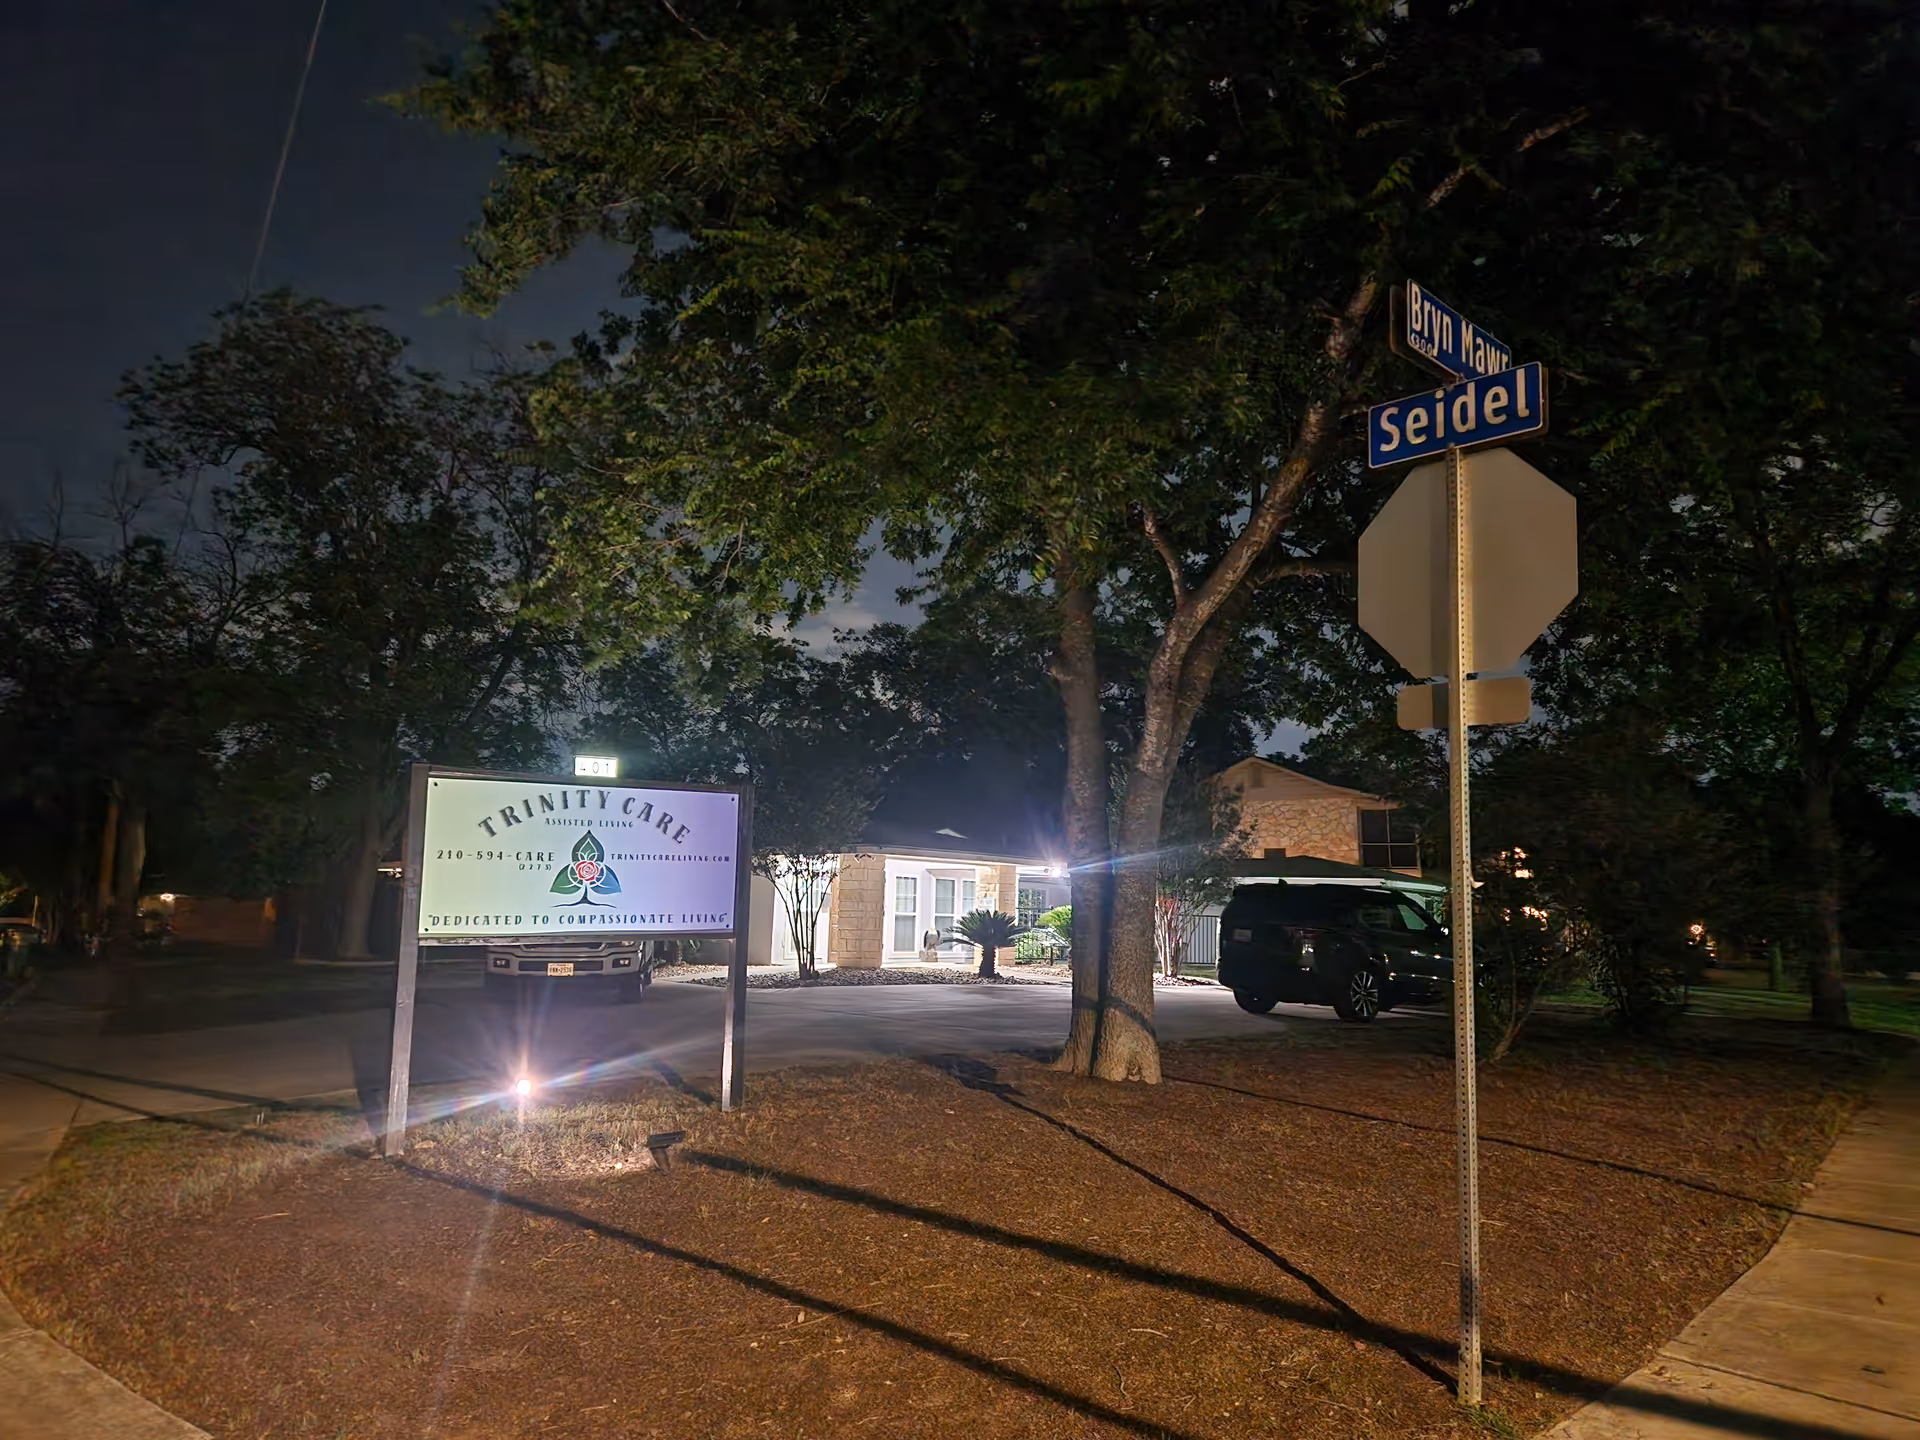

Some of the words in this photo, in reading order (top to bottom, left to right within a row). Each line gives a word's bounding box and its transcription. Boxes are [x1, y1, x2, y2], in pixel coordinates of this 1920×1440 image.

[1411, 283, 1453, 357] Bryn
[1460, 320, 1509, 375] Mawr
[1379, 367, 1530, 452] Seidel
[478, 789, 612, 838] TRINITY
[622, 797, 691, 844] CARE
[545, 817, 593, 828] ASSISTED
[599, 819, 634, 828] LIVING
[437, 850, 555, 862] 210-594-CARE
[611, 853, 730, 862] TRINITYCARELIVING.COM
[531, 914, 550, 925] TO
[558, 914, 674, 925] COMPASSIONATE
